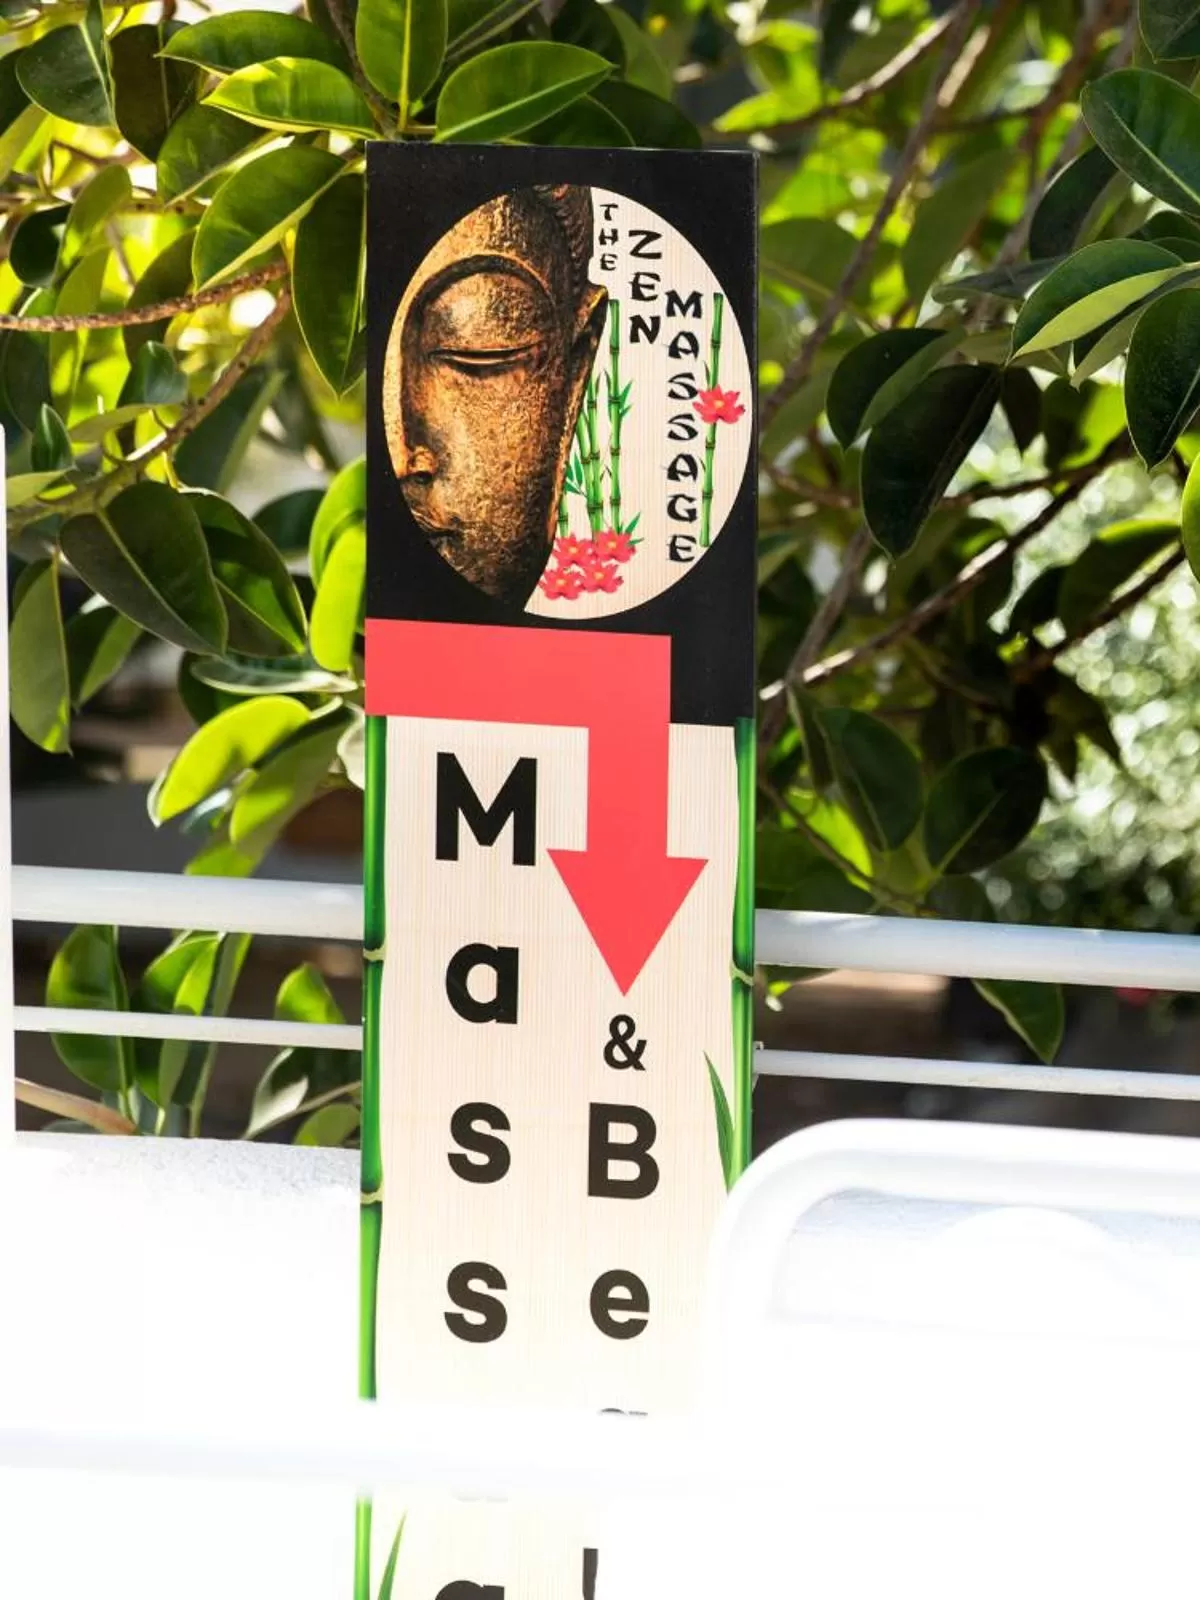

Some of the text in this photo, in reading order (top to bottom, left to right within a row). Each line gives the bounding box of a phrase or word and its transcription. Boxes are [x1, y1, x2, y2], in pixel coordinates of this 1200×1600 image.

[598, 203, 619, 272] THE
[627, 229, 664, 344] ZEN
[665, 289, 704, 563] MASSAGE
[434, 751, 537, 1600] Mass
[582, 1013, 660, 1600] & Be
